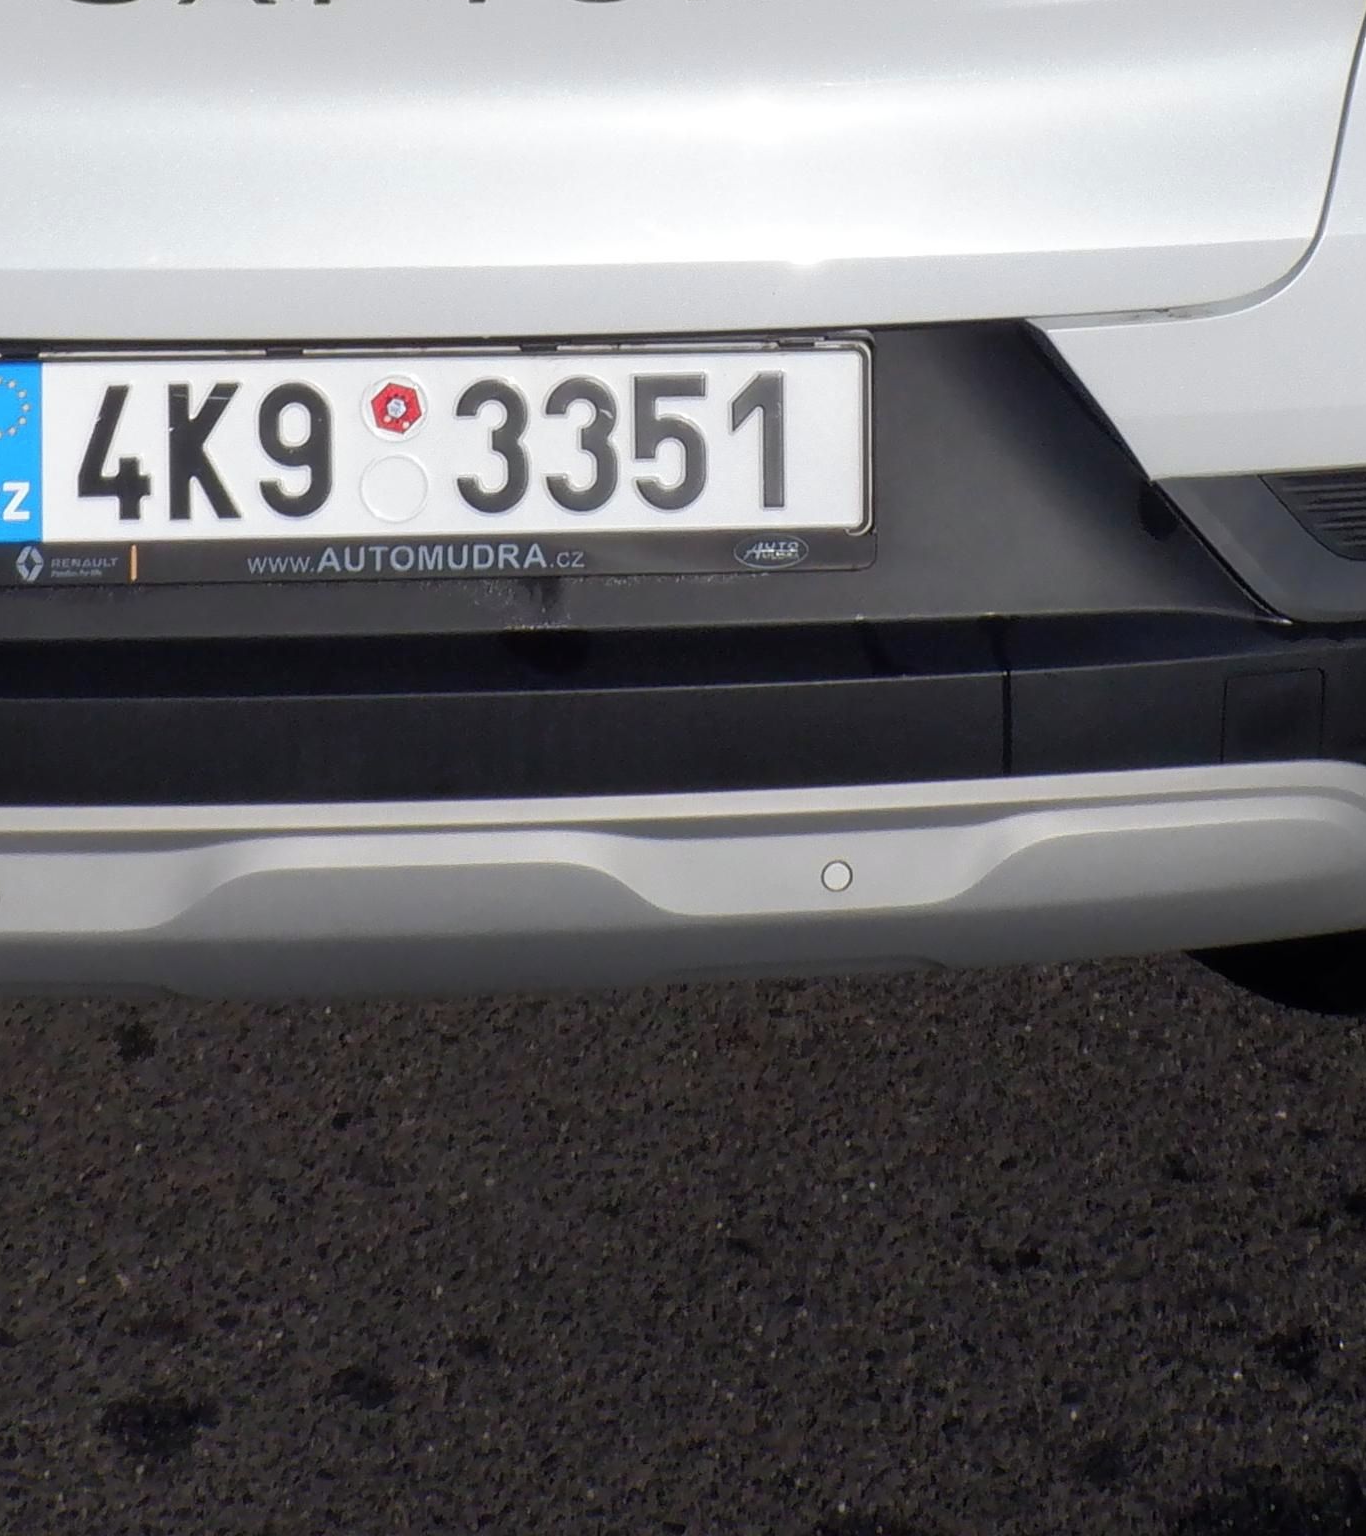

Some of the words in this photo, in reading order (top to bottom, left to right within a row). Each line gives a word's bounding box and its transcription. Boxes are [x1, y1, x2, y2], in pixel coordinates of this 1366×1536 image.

[76, 382, 334, 523] 4K9
[455, 370, 786, 515] 3351
[49, 556, 119, 569] RENAULT
